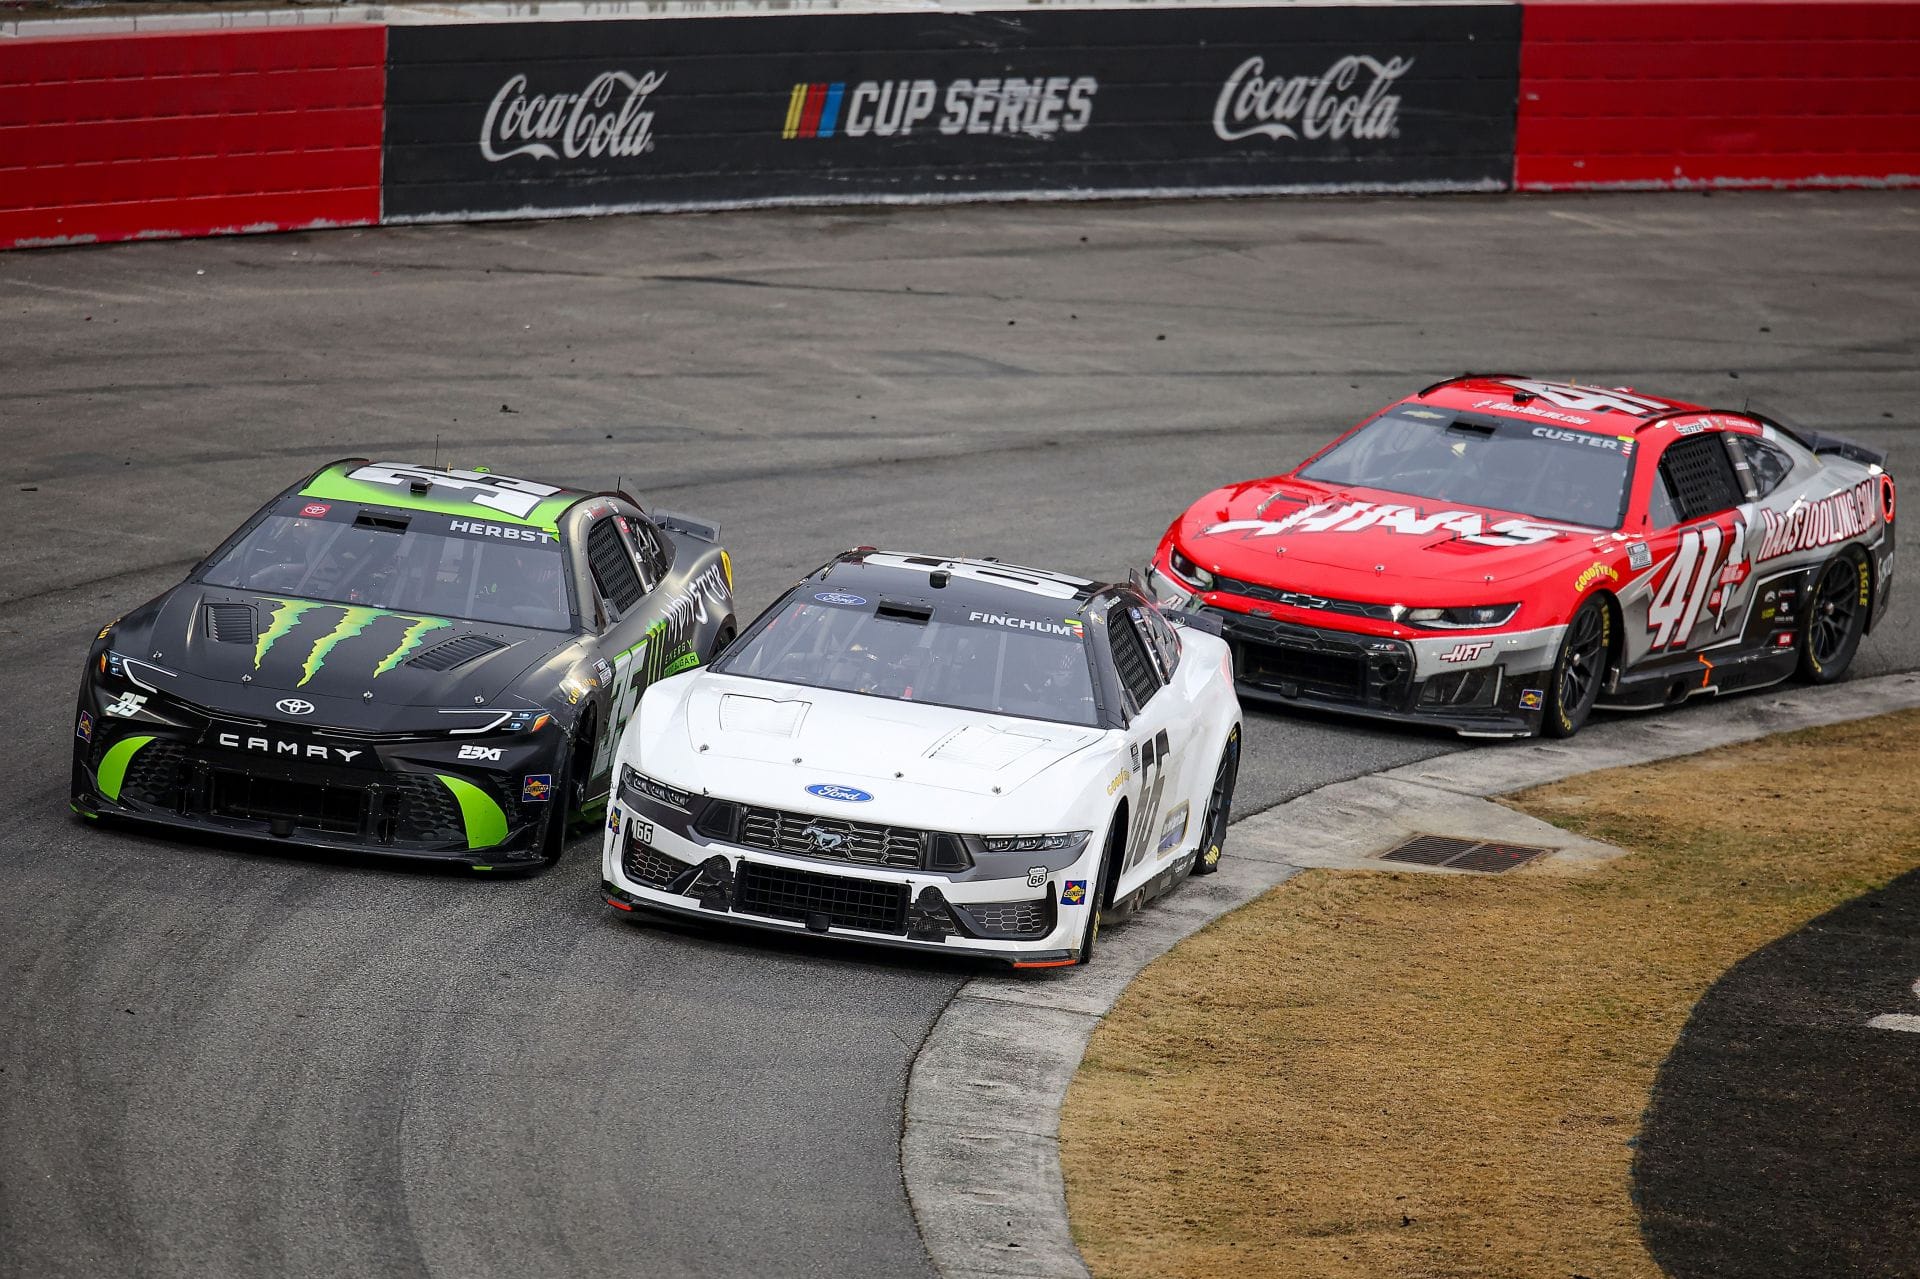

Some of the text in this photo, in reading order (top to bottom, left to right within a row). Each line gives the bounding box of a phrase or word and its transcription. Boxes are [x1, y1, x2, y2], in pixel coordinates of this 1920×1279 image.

[845, 77, 1098, 136] CUP SERIES
[1212, 55, 1414, 141] Coca-Cola
[480, 70, 668, 162] Coca-Cola
[1532, 427, 1618, 450] CUSTER
[450, 520, 552, 544] HERBST
[1574, 562, 1619, 592] GOODYEAR
[1649, 527, 1722, 650] 41
[969, 611, 1071, 637] FINCHUM
[105, 692, 148, 717] 35
[219, 733, 362, 762] CAMRY
[818, 785, 861, 801] Ford
[636, 821, 653, 844] 66
[1030, 874, 1044, 885] 66
